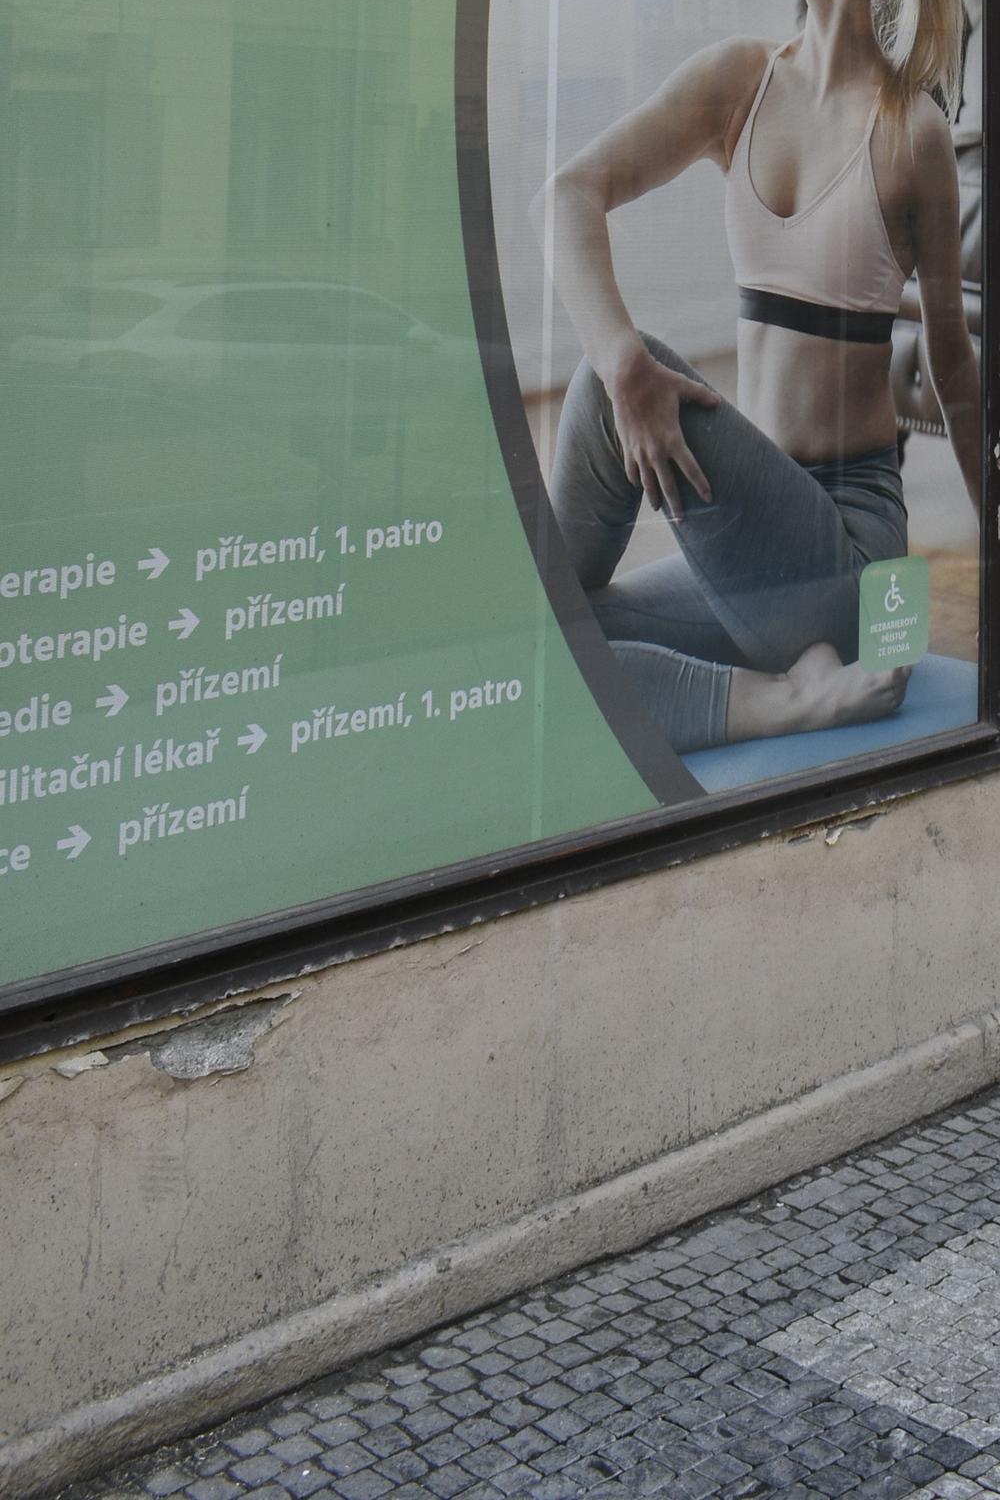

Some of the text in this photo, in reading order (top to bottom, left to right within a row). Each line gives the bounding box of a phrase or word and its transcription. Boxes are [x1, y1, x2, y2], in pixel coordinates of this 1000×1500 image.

[195, 527, 325, 581] přízemí,
[335, 527, 356, 554] 1.
[366, 518, 443, 557] patro
[224, 584, 346, 639] přízemí
[156, 653, 284, 715] přízemí
[134, 728, 220, 778] lékař
[291, 692, 412, 752] přízemí,
[421, 690, 440, 718] 1.
[449, 678, 523, 720] patro
[119, 786, 250, 854] přízemí
